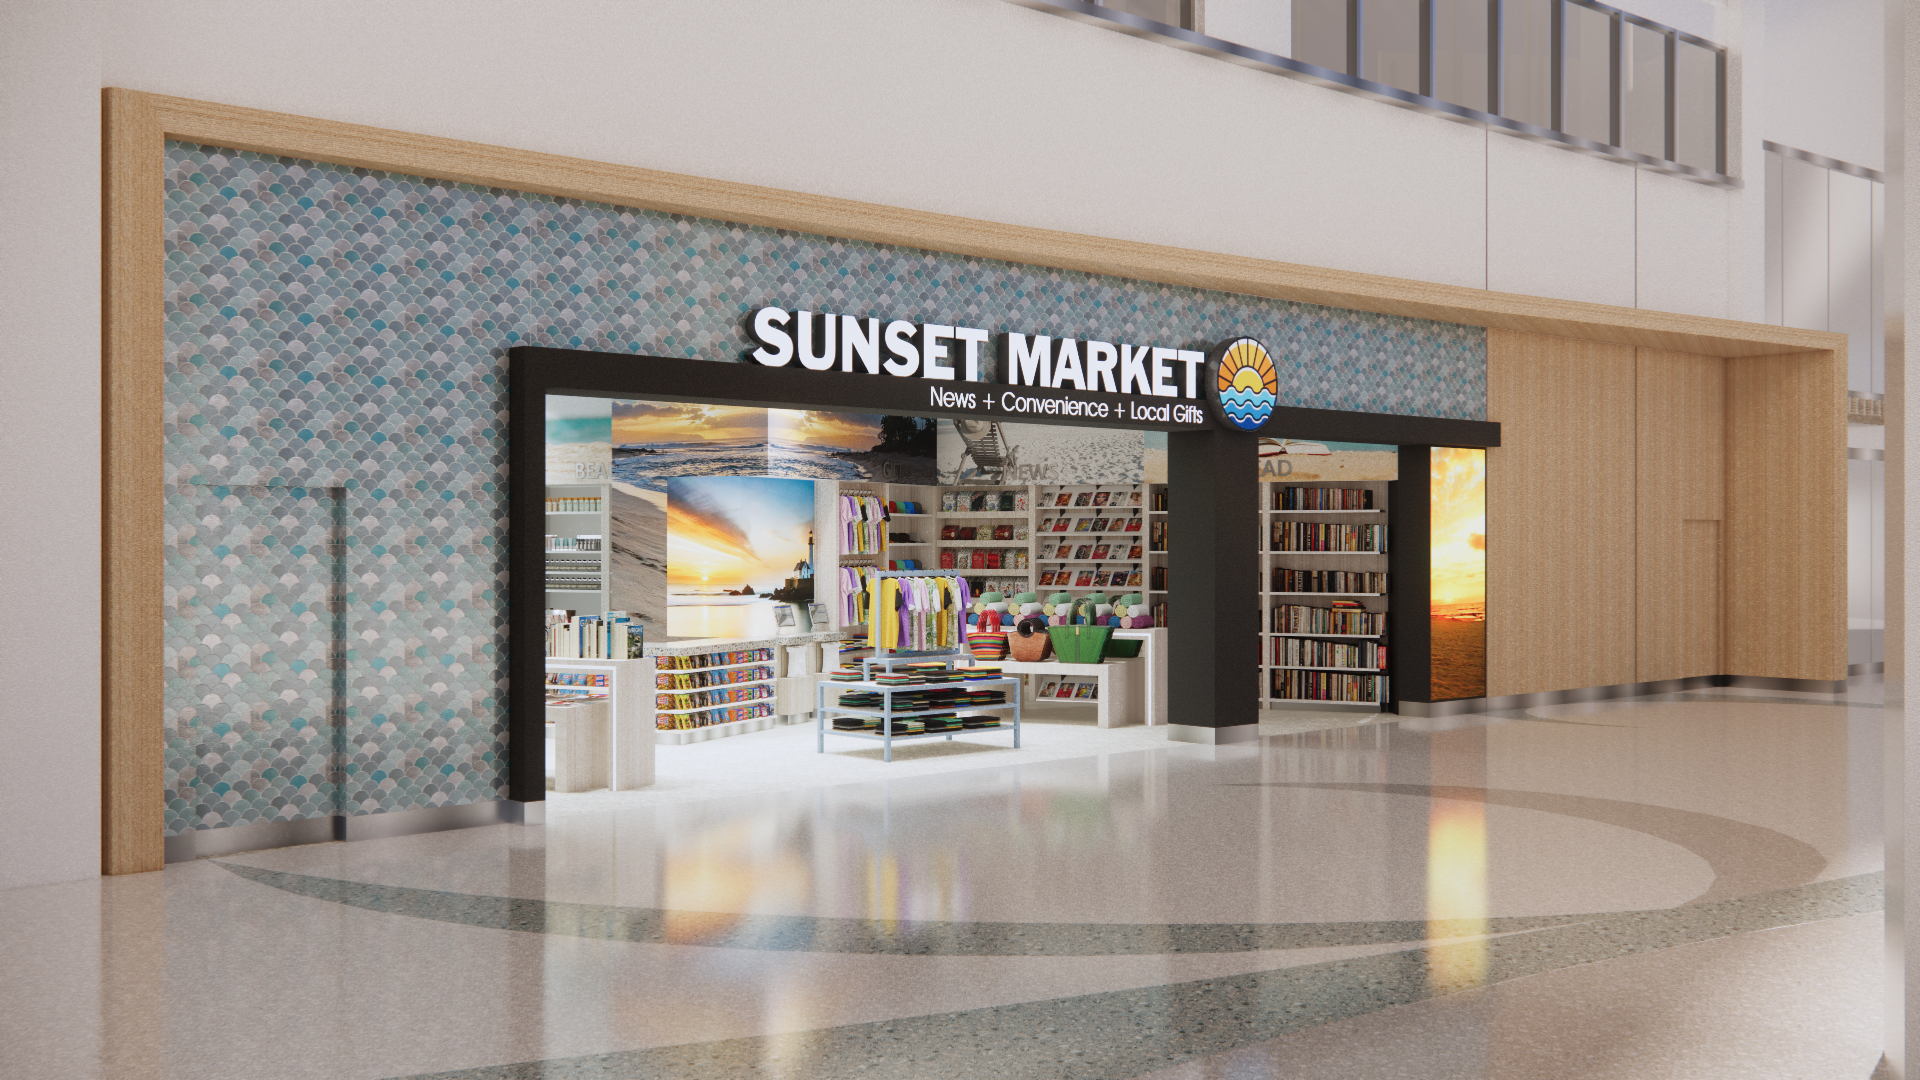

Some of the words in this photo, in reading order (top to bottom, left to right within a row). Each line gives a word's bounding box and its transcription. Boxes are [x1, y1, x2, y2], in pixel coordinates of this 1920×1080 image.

[752, 306, 989, 382] SUNSET
[1007, 332, 1205, 399] MARKET
[930, 385, 977, 410] News
[982, 393, 996, 410] +
[1001, 391, 1109, 418] Convenience
[1114, 402, 1126, 419] +
[1130, 401, 1170, 422] Local
[1173, 404, 1204, 424] Gifts
[1003, 463, 1059, 481] NEWS
